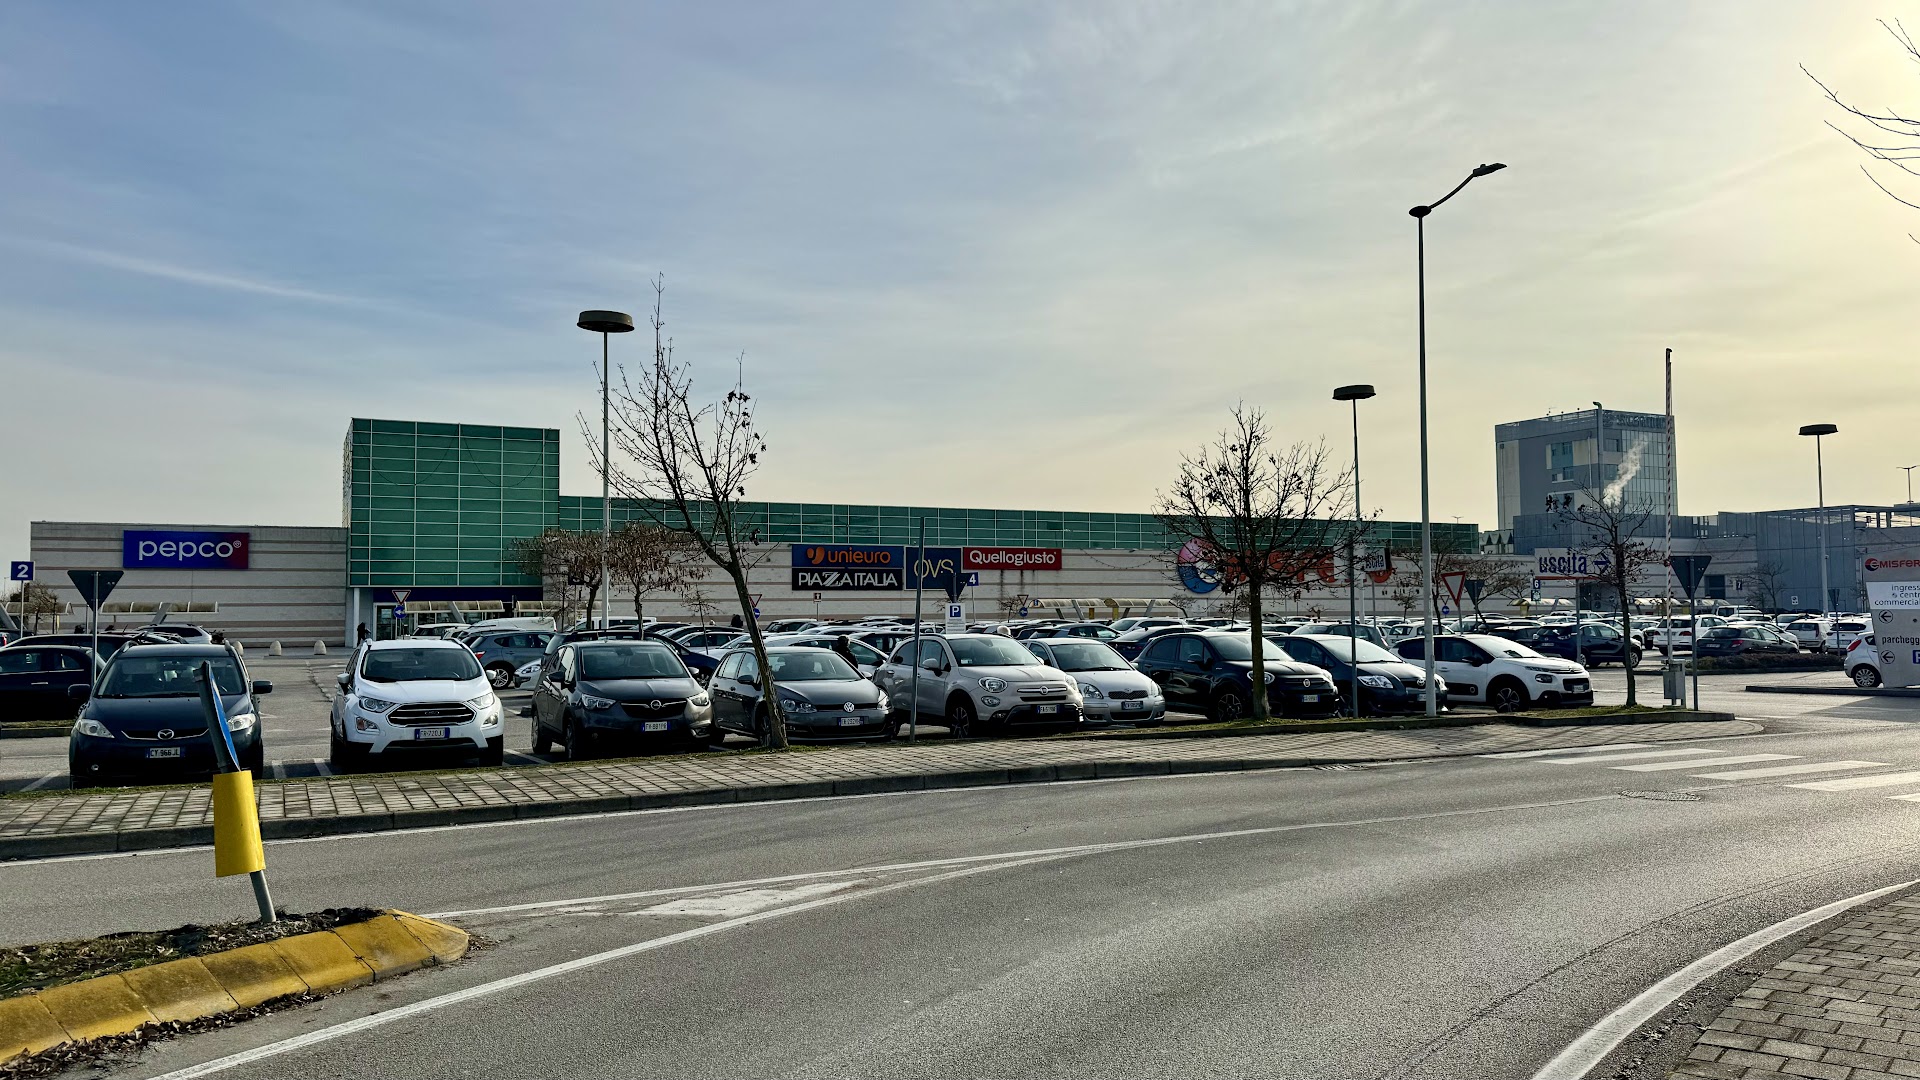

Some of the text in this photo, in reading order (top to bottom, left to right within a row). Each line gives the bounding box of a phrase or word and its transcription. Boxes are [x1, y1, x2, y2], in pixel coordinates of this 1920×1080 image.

[138, 540, 234, 561] pepco
[827, 546, 891, 564] unieuro
[969, 549, 1056, 566] Quellogiusto
[16, 564, 29, 578] 2
[1539, 552, 1588, 574] uscita
[798, 571, 898, 588] PIAZZA ITALIA
[969, 573, 976, 585] 4
[1534, 580, 1539, 589] 6
[951, 606, 960, 617] P
